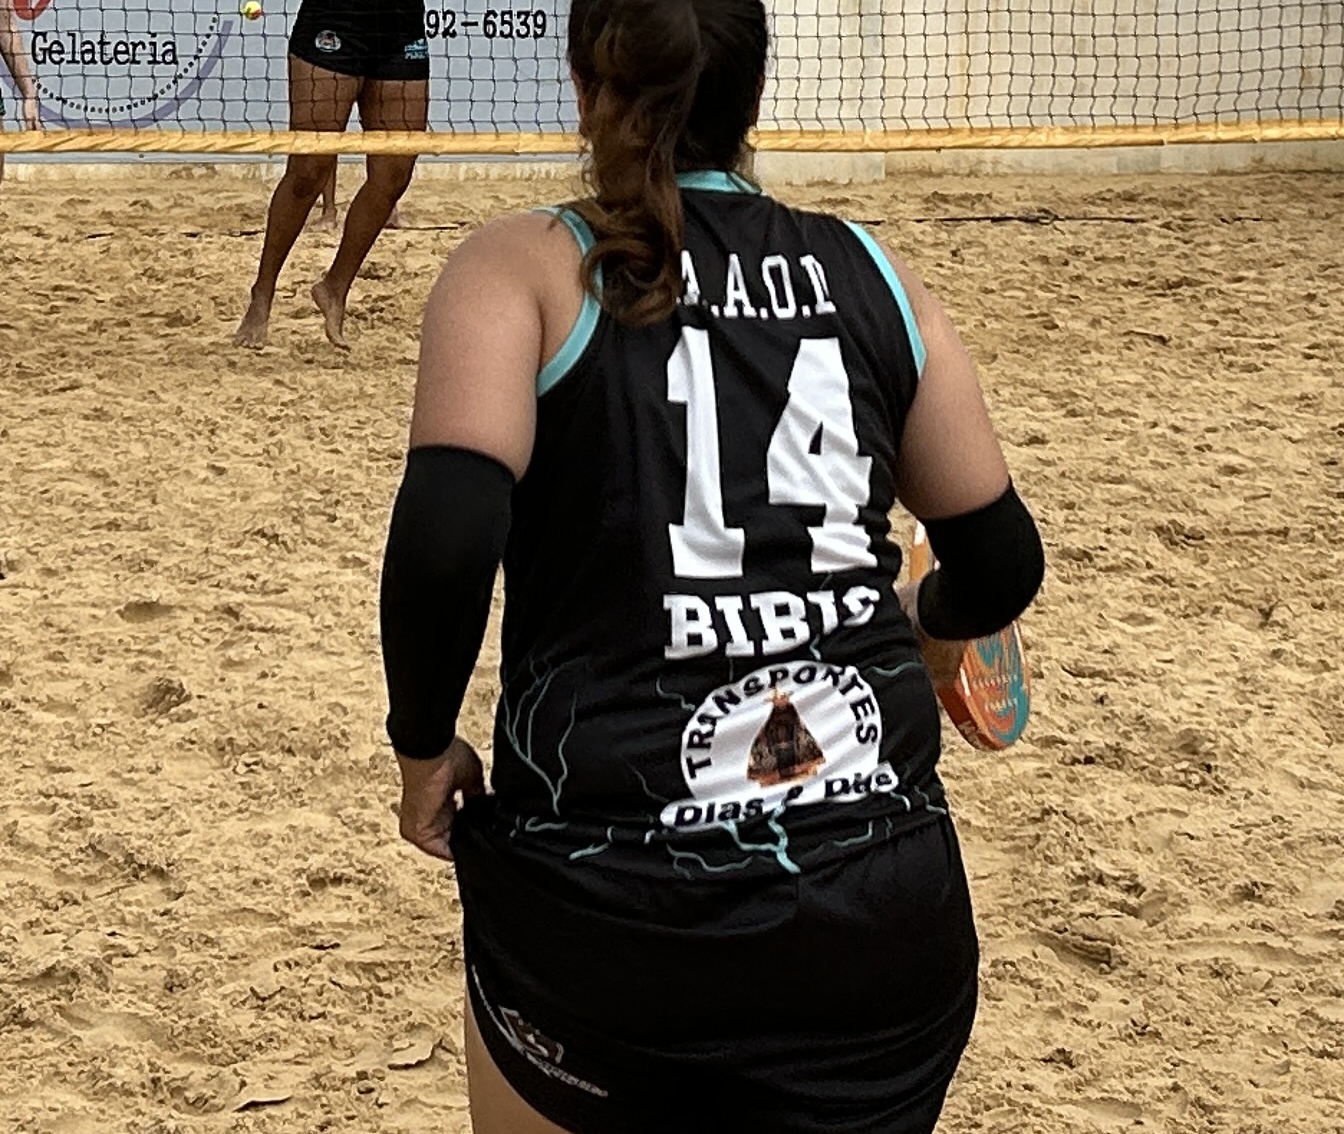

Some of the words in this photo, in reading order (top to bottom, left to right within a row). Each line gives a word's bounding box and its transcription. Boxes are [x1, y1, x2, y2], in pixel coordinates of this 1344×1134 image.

[426, 9, 548, 39] 92-6539
[31, 30, 179, 66] Gelateria
[666, 325, 879, 579] 14
[674, 797, 766, 827] Dias
